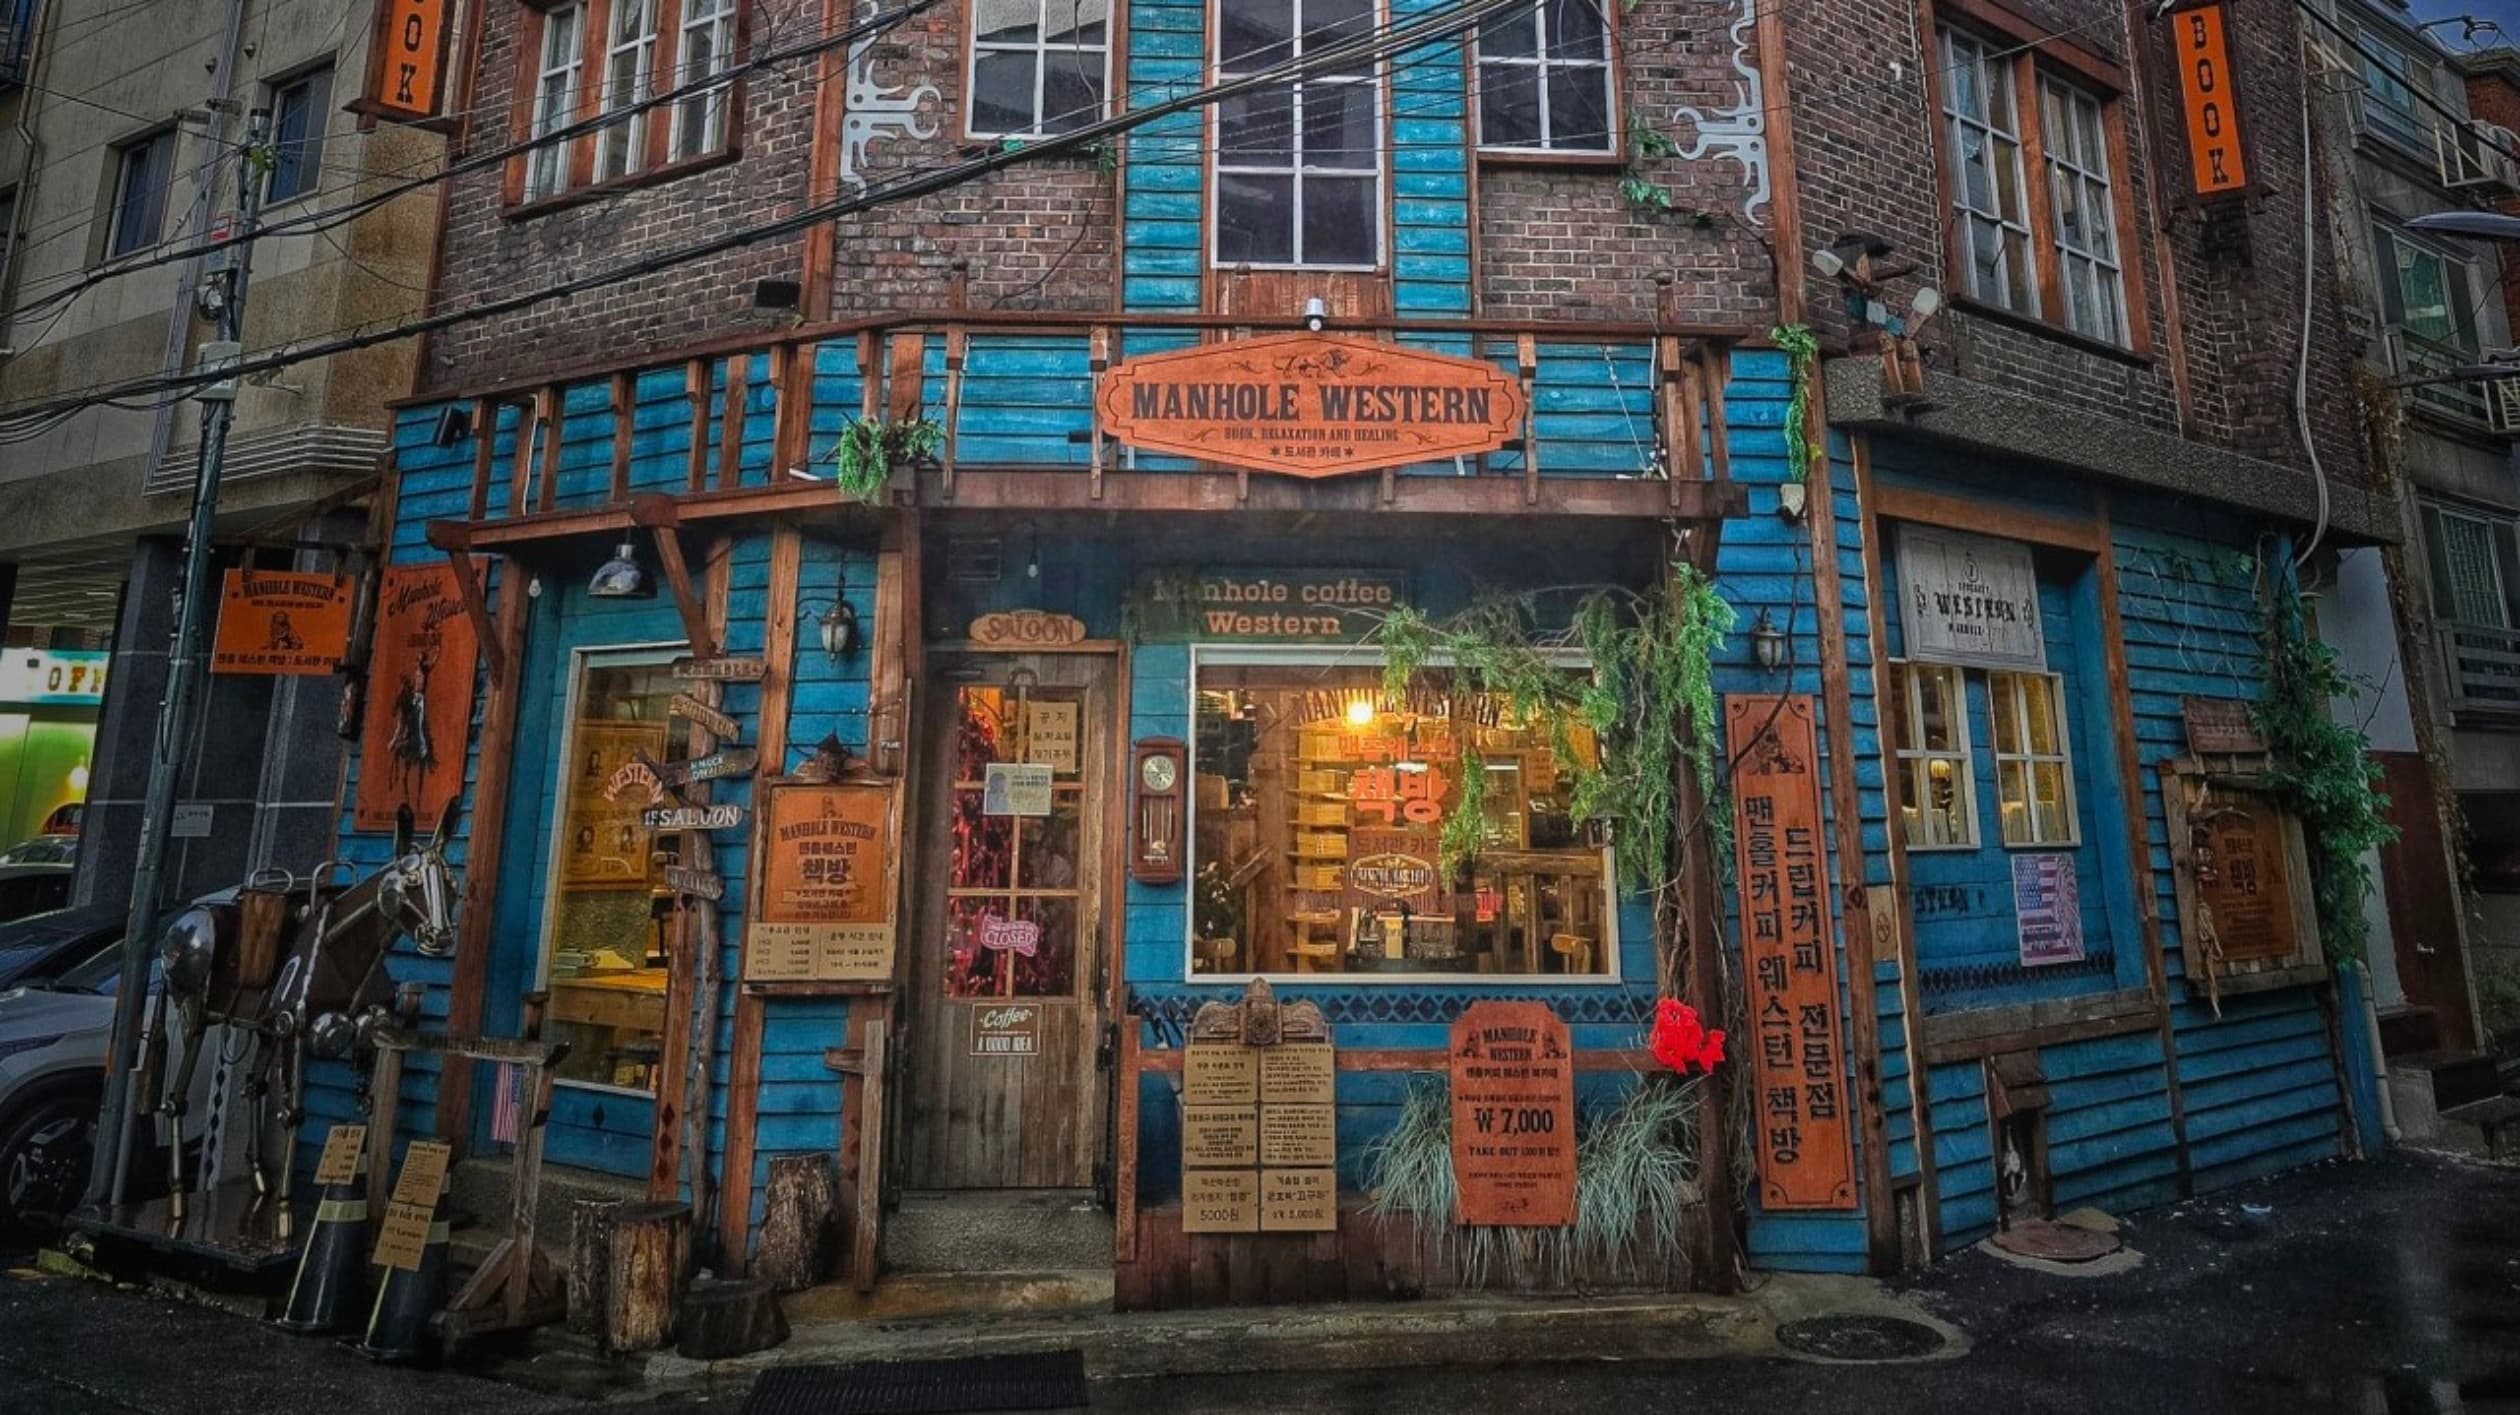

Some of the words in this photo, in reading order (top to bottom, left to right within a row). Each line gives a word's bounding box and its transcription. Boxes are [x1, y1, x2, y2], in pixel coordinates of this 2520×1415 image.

[396, 0, 424, 104] OK
[2191, 15, 2229, 184] BOOK
[1131, 383, 1299, 421] MANHOLE
[1317, 384, 1492, 425] WESTERN
[1261, 428, 1325, 441] RELAXATION
[1329, 428, 1351, 441] AND
[1284, 446, 1316, 457] 도서관
[1319, 446, 1342, 458] 카페
[293, 580, 336, 601] WESTERN
[1301, 578, 1392, 603] coffee
[1934, 592, 2016, 622] WESTERN
[984, 617, 1073, 641] SALOON
[1205, 610, 1342, 635] Western
[1349, 766, 1448, 823] 책방
[659, 805, 737, 827] SALOON
[780, 821, 828, 842] MANHOLE
[830, 821, 876, 840] WESTERN
[1408, 834, 1437, 854] 카
[803, 858, 850, 885] 책방
[1744, 795, 1783, 945] 맨홀커피
[1785, 827, 1823, 975] 드립커피
[1914, 886, 1969, 914] STERN
[985, 930, 1034, 946] CLOSED
[982, 1007, 1031, 1030] Coffee
[1757, 955, 1793, 1072] 웨스턴
[977, 1036, 983, 1052] A
[1483, 1027, 1538, 1043] MANHOLE
[1489, 1048, 1532, 1061] WESTERN
[1800, 1003, 1836, 1120] 전문점
[1501, 1108, 1554, 1136] 7,000
[1766, 1085, 1801, 1165] 책방
[1468, 1146, 1495, 1156] TAKE
[1499, 1147, 1518, 1156] OUT
